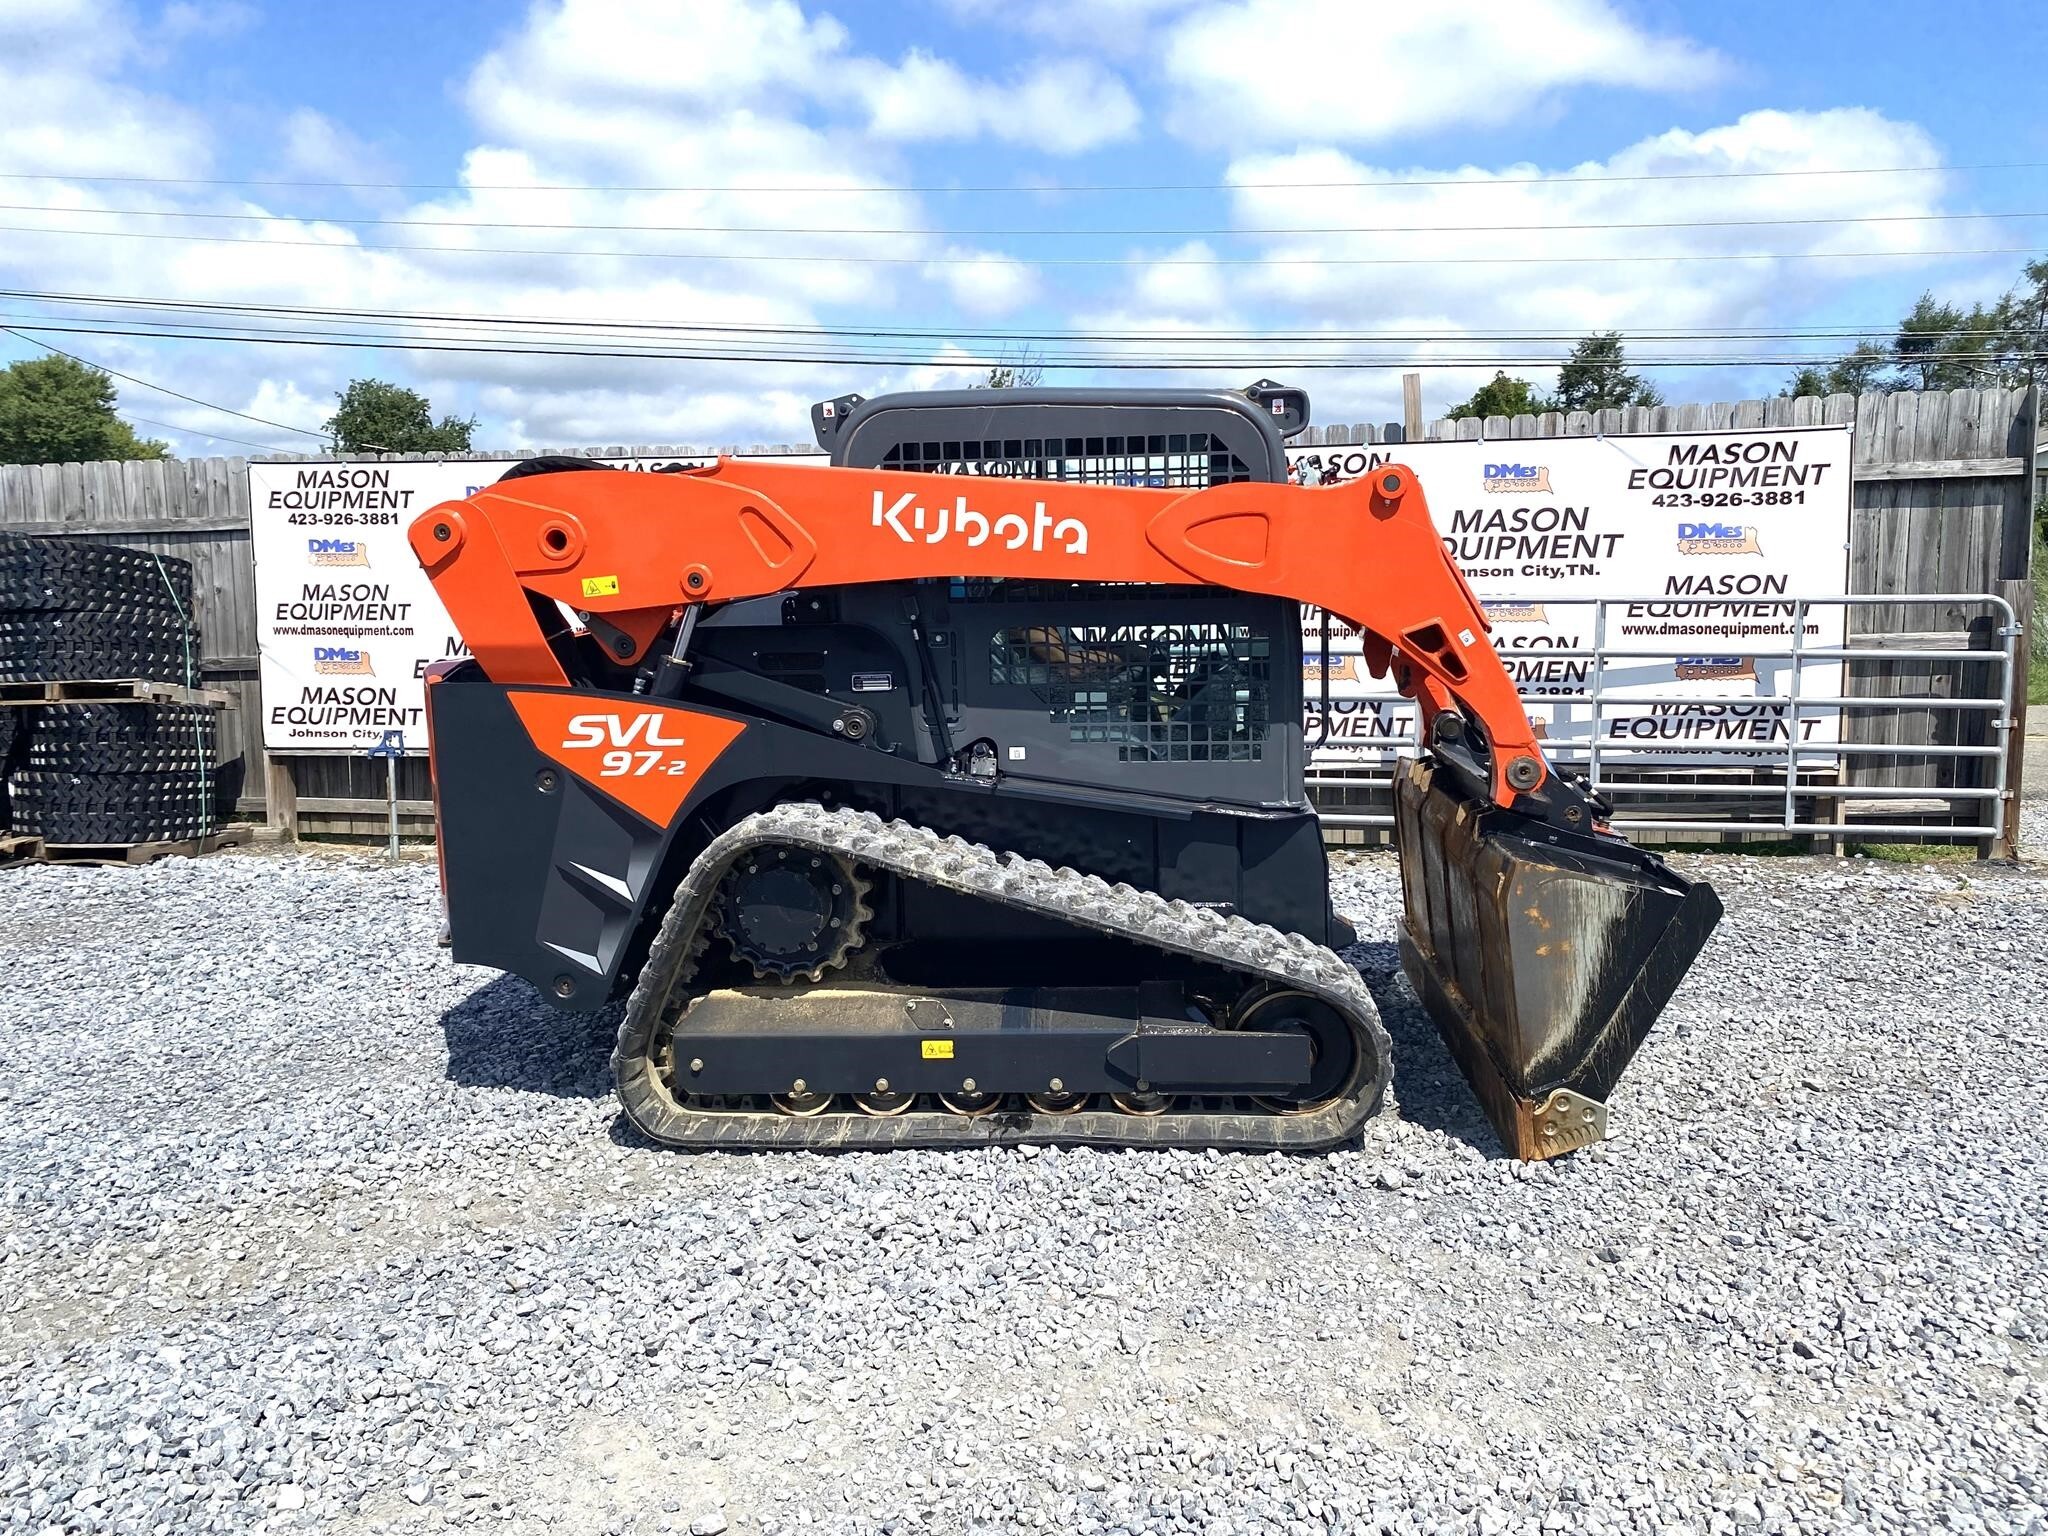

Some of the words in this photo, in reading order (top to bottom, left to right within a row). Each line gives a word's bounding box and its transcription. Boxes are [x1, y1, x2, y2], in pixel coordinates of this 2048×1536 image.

[1668, 441, 1799, 465] MASON
[297, 470, 390, 489] MASON
[1627, 463, 1831, 489] EQUIPMENT
[268, 490, 415, 509] EQUIPMENT
[1652, 490, 1805, 507] 423-926-3881
[288, 513, 399, 525] 423-926-3881
[871, 490, 1088, 555] Kubota
[1451, 506, 1589, 533] MASON
[1441, 533, 1624, 561] QUIPMENT
[302, 584, 389, 601] MASON
[1665, 574, 1788, 595] MASON
[276, 603, 411, 621] EQUIPMENT
[273, 625, 414, 638] www.dmasonequipment.com
[300, 687, 396, 705] MASON
[271, 707, 423, 726] EQUIPMENT
[289, 729, 347, 738] Johnson
[562, 713, 684, 748] SVL
[1304, 717, 1414, 737] PMENT
[600, 751, 687, 776] 97-2
